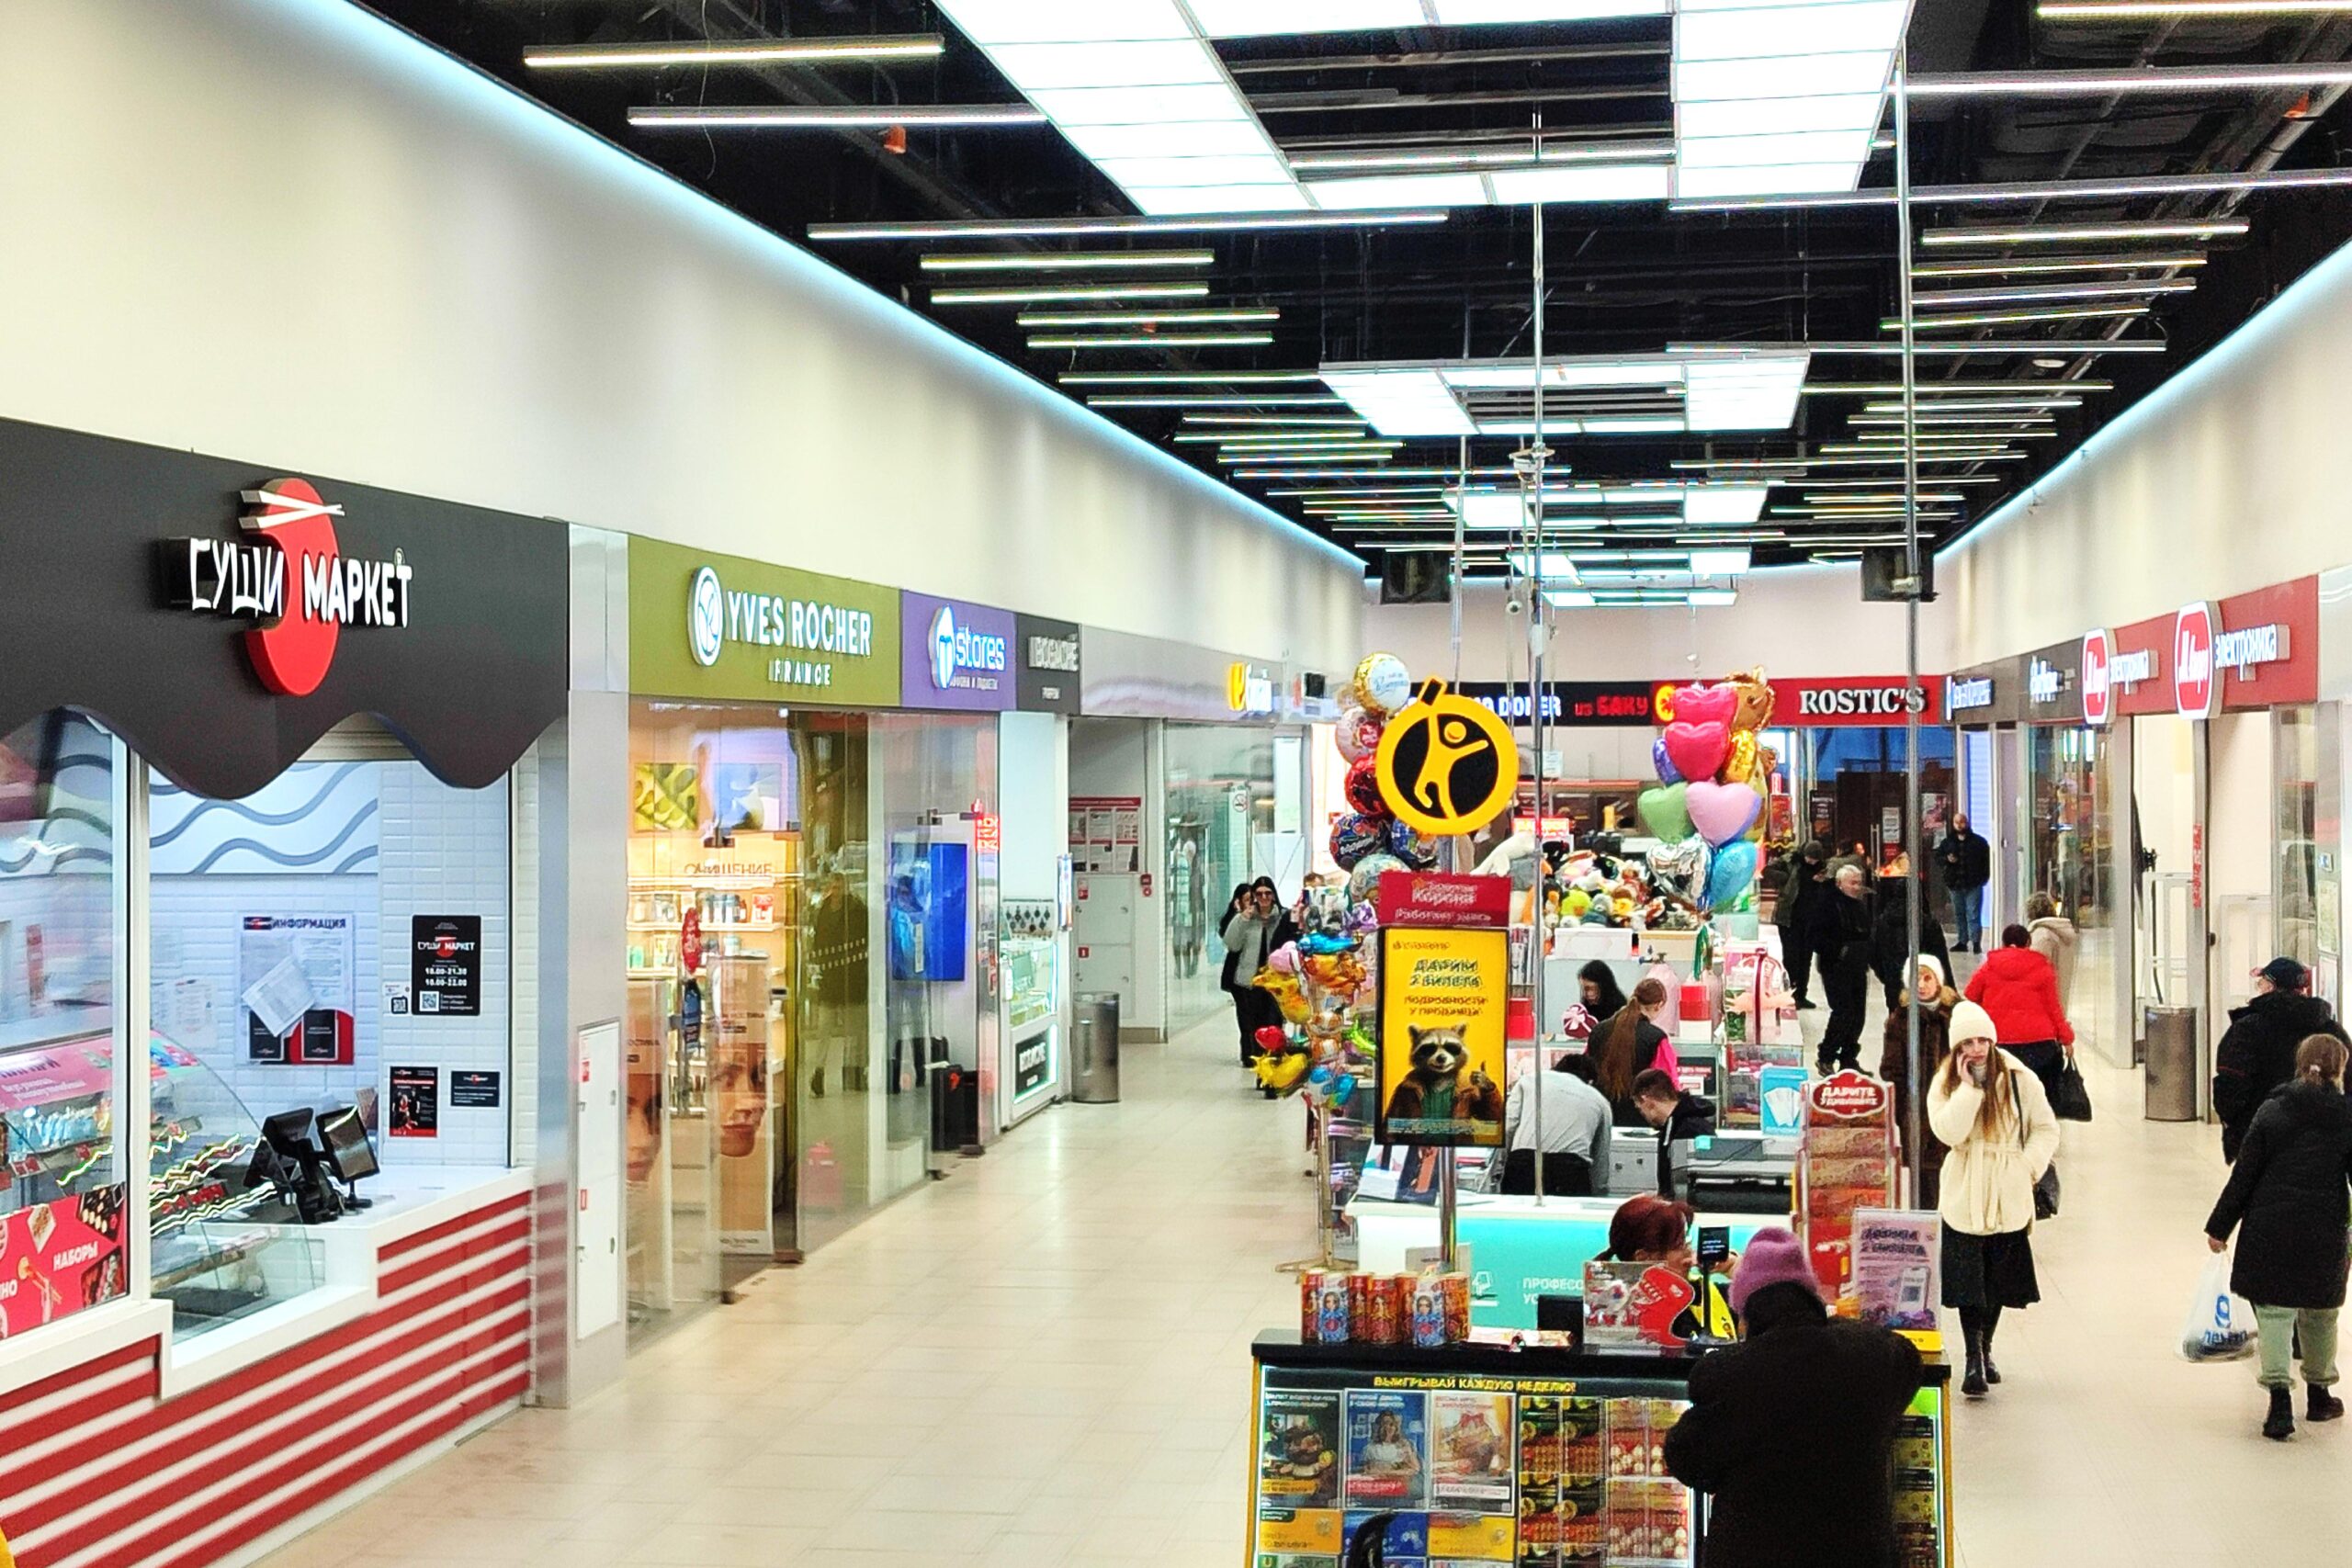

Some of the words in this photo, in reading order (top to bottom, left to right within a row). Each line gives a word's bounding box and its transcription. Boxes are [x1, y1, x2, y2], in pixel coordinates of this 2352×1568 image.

[304, 553, 413, 628] МАРКЕТ
[727, 591, 785, 646] YVES
[791, 600, 872, 657] ROCHER
[770, 658, 832, 685] FRANCE
[1799, 687, 1926, 715] ROSTIC'S
[272, 919, 346, 930] ИНФОРМАЦИЯ
[53, 1240, 99, 1272] НАБОРЫ
[1374, 1376, 1456, 1389] ВЫИГРЫВАЙ
[1459, 1377, 1514, 1391] КАЖДУЮ
[1517, 1381, 1577, 1393] НЕДЕЛЮ!
